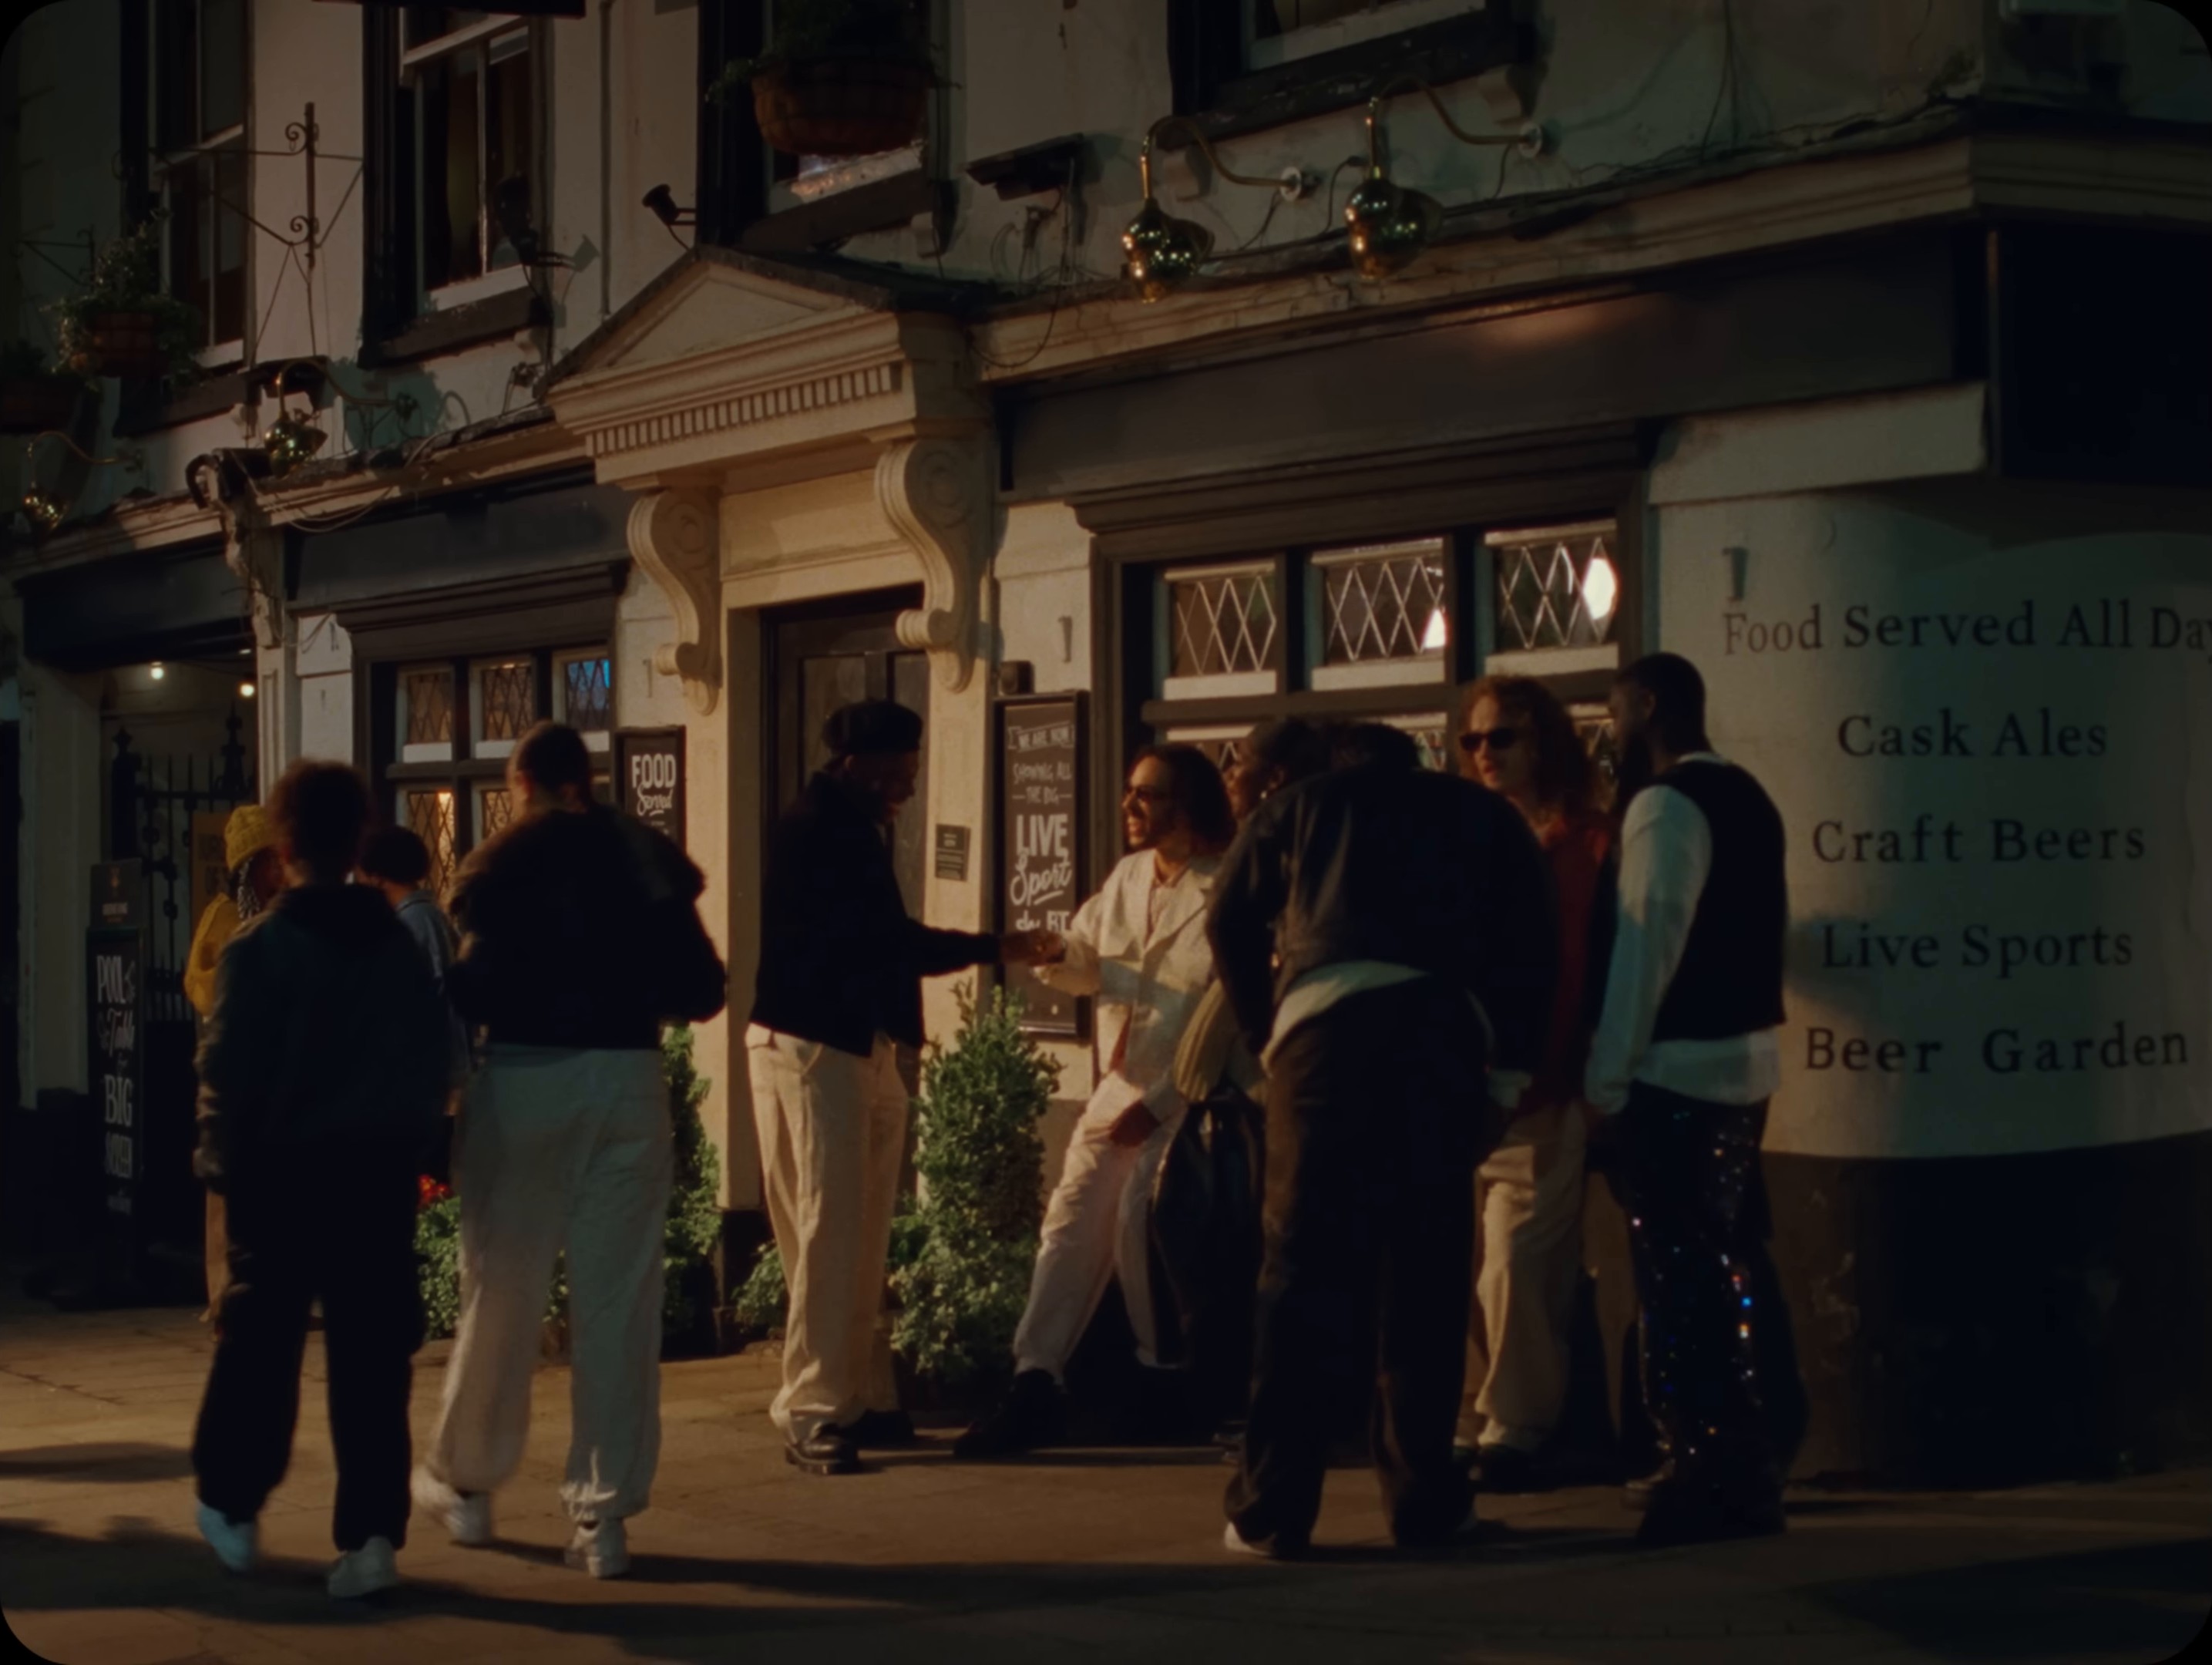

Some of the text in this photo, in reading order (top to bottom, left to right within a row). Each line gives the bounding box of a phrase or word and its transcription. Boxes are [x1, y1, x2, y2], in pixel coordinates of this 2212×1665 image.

[1723, 604, 1824, 655] Food
[1844, 600, 2036, 648] Served
[2056, 598, 2133, 648] All
[1838, 708, 2108, 758] Cask Ales
[631, 753, 677, 789] FOOD
[637, 783, 674, 816] Served
[1016, 813, 1069, 857] LIVE
[1813, 814, 2145, 863] Craft Beers
[1010, 847, 1073, 907] Sport
[1822, 923, 2133, 979] Live Sports
[96, 954, 126, 1004] POOL
[1806, 1021, 2189, 1074] Beer Garden
[103, 1074, 133, 1128] BIG
